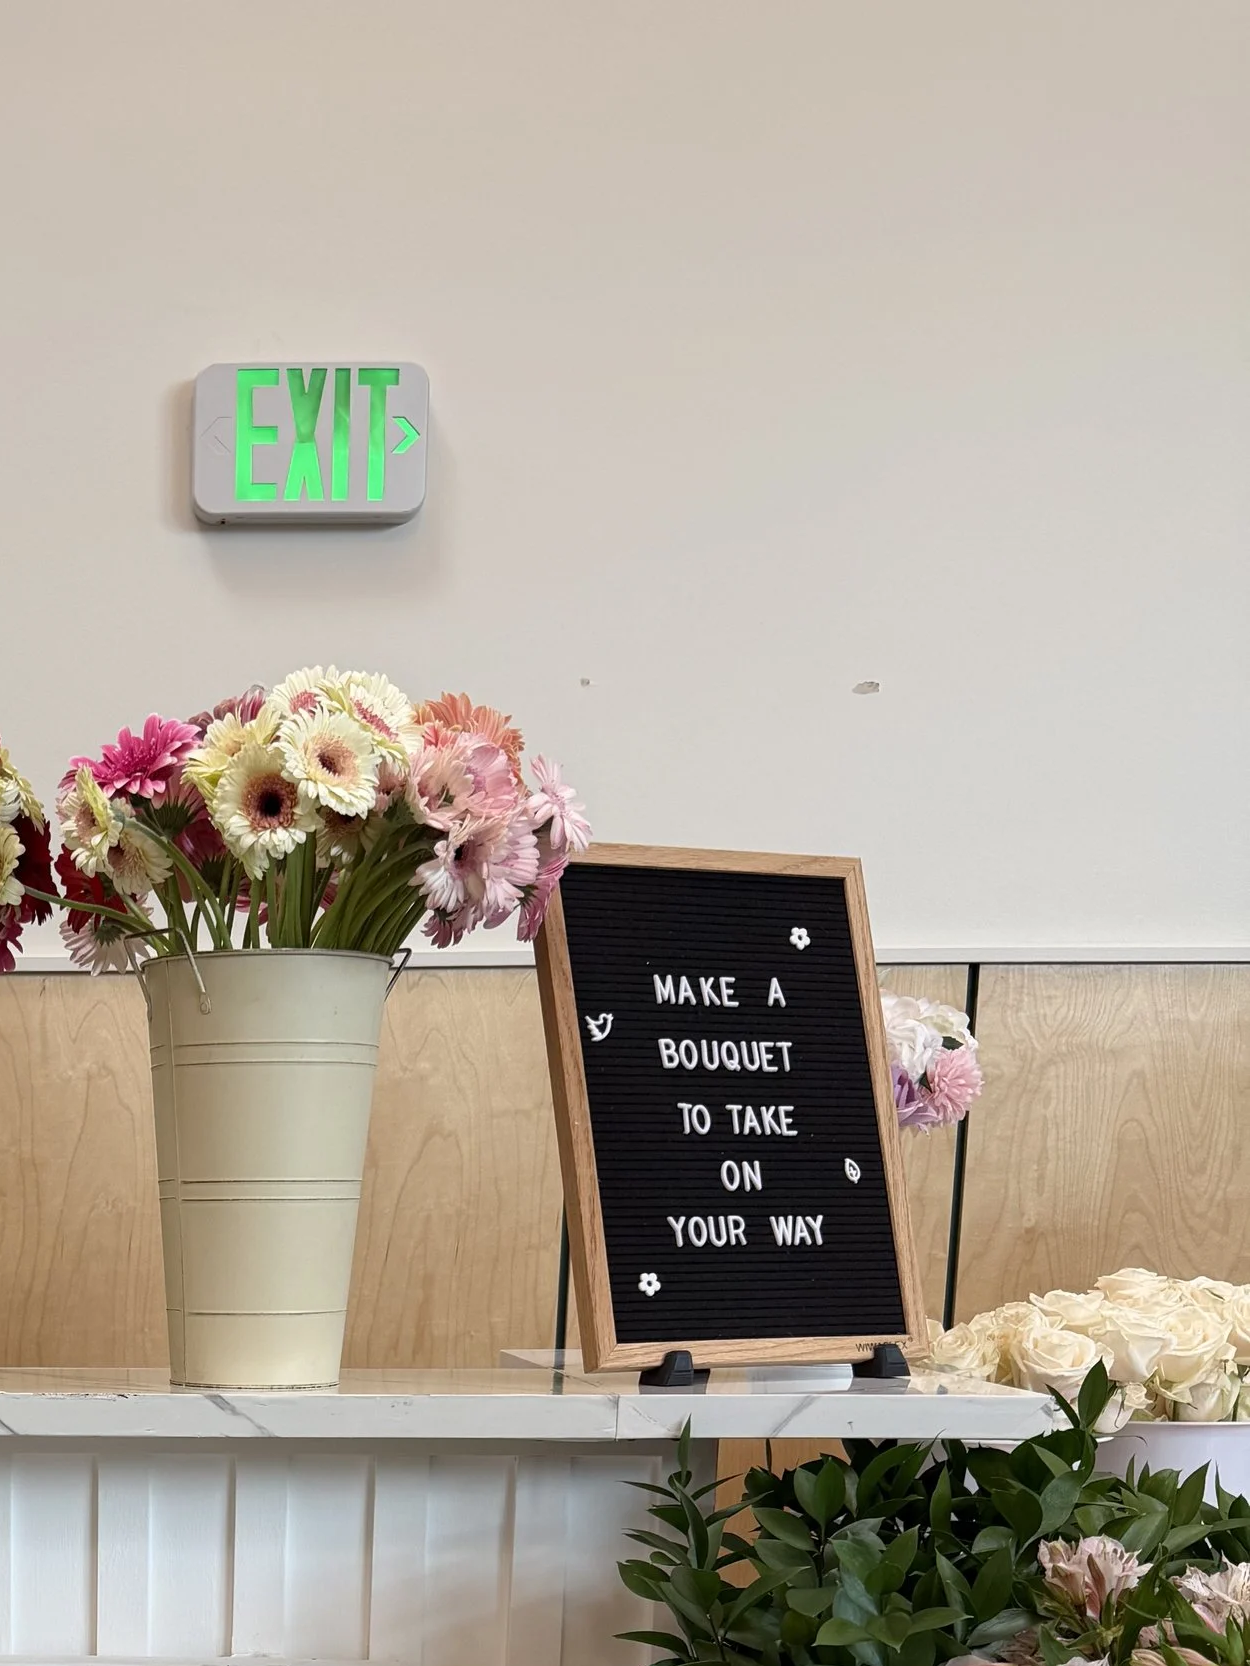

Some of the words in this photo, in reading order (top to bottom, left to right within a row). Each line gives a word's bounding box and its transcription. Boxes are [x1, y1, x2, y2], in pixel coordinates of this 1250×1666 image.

[235, 368, 400, 502] EXIT
[654, 975, 739, 1006] MAKE
[768, 978, 785, 1006] A
[659, 1039, 792, 1071] BOUQUET
[678, 1103, 710, 1134] TO
[726, 1105, 797, 1135] TAKE
[721, 1161, 762, 1191] ON
[668, 1216, 746, 1247] YOUR
[770, 1215, 823, 1245] WAY
